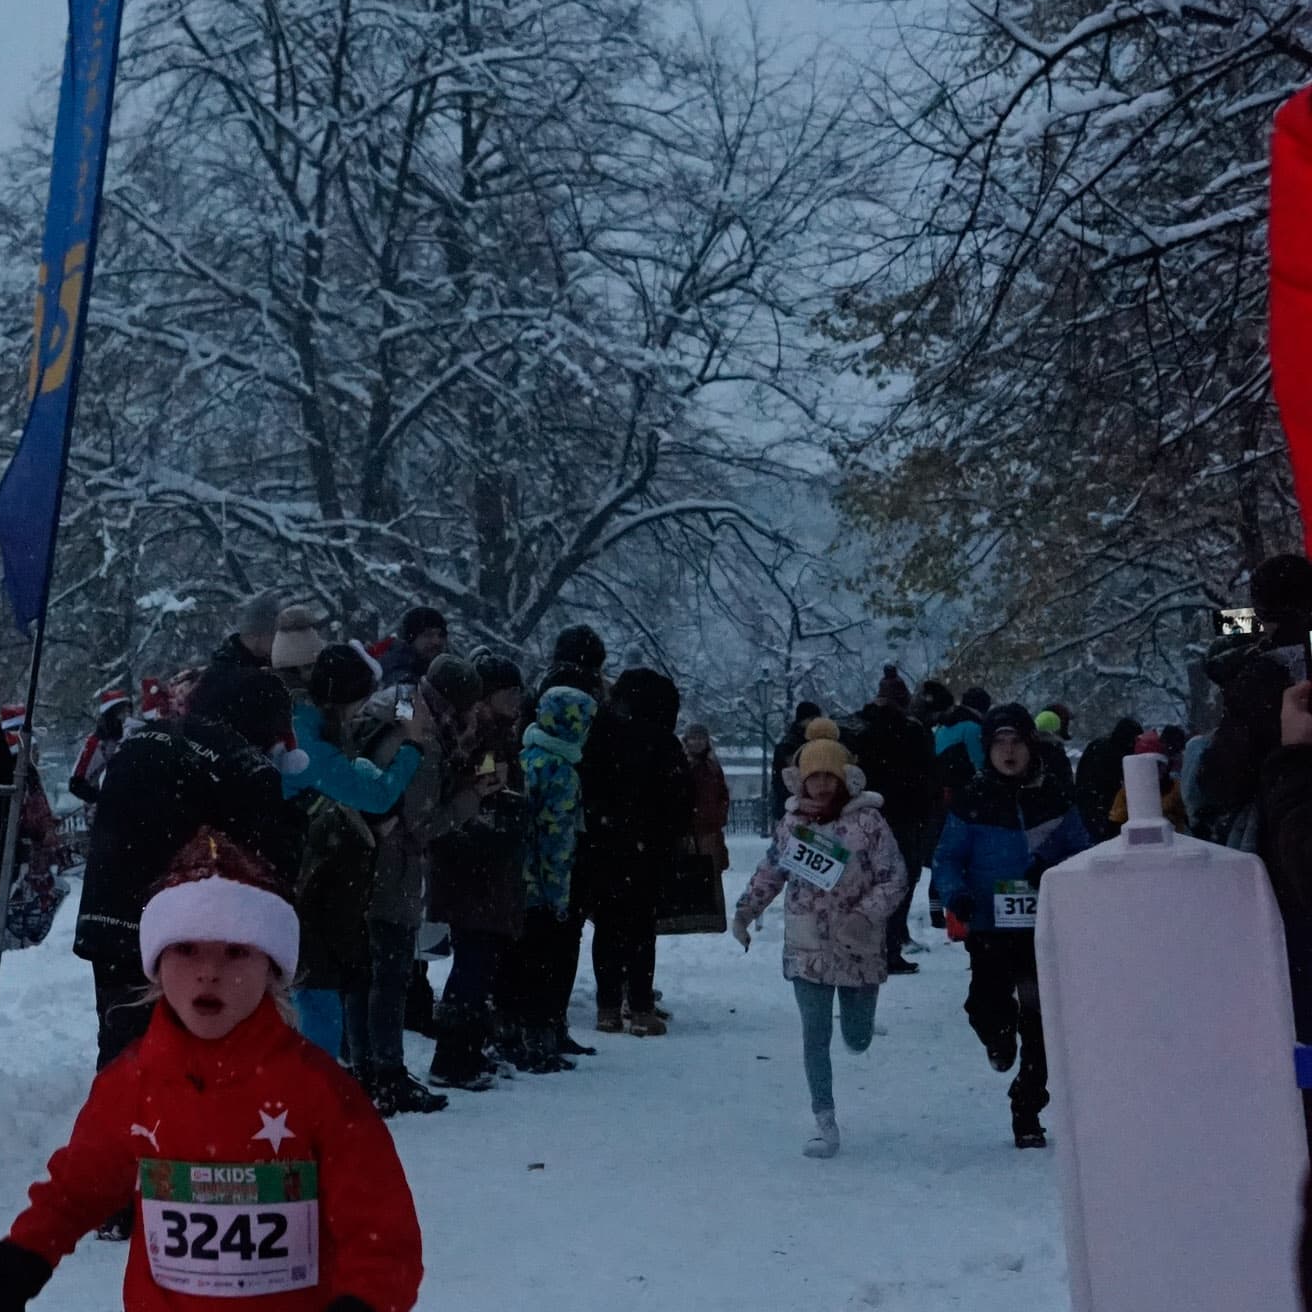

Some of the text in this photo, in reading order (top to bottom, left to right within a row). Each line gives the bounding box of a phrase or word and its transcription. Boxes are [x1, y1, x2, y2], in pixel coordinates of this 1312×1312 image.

[793, 843, 834, 874] 3187
[214, 1167, 257, 1183] KIDS
[162, 1210, 288, 1261] 3242
